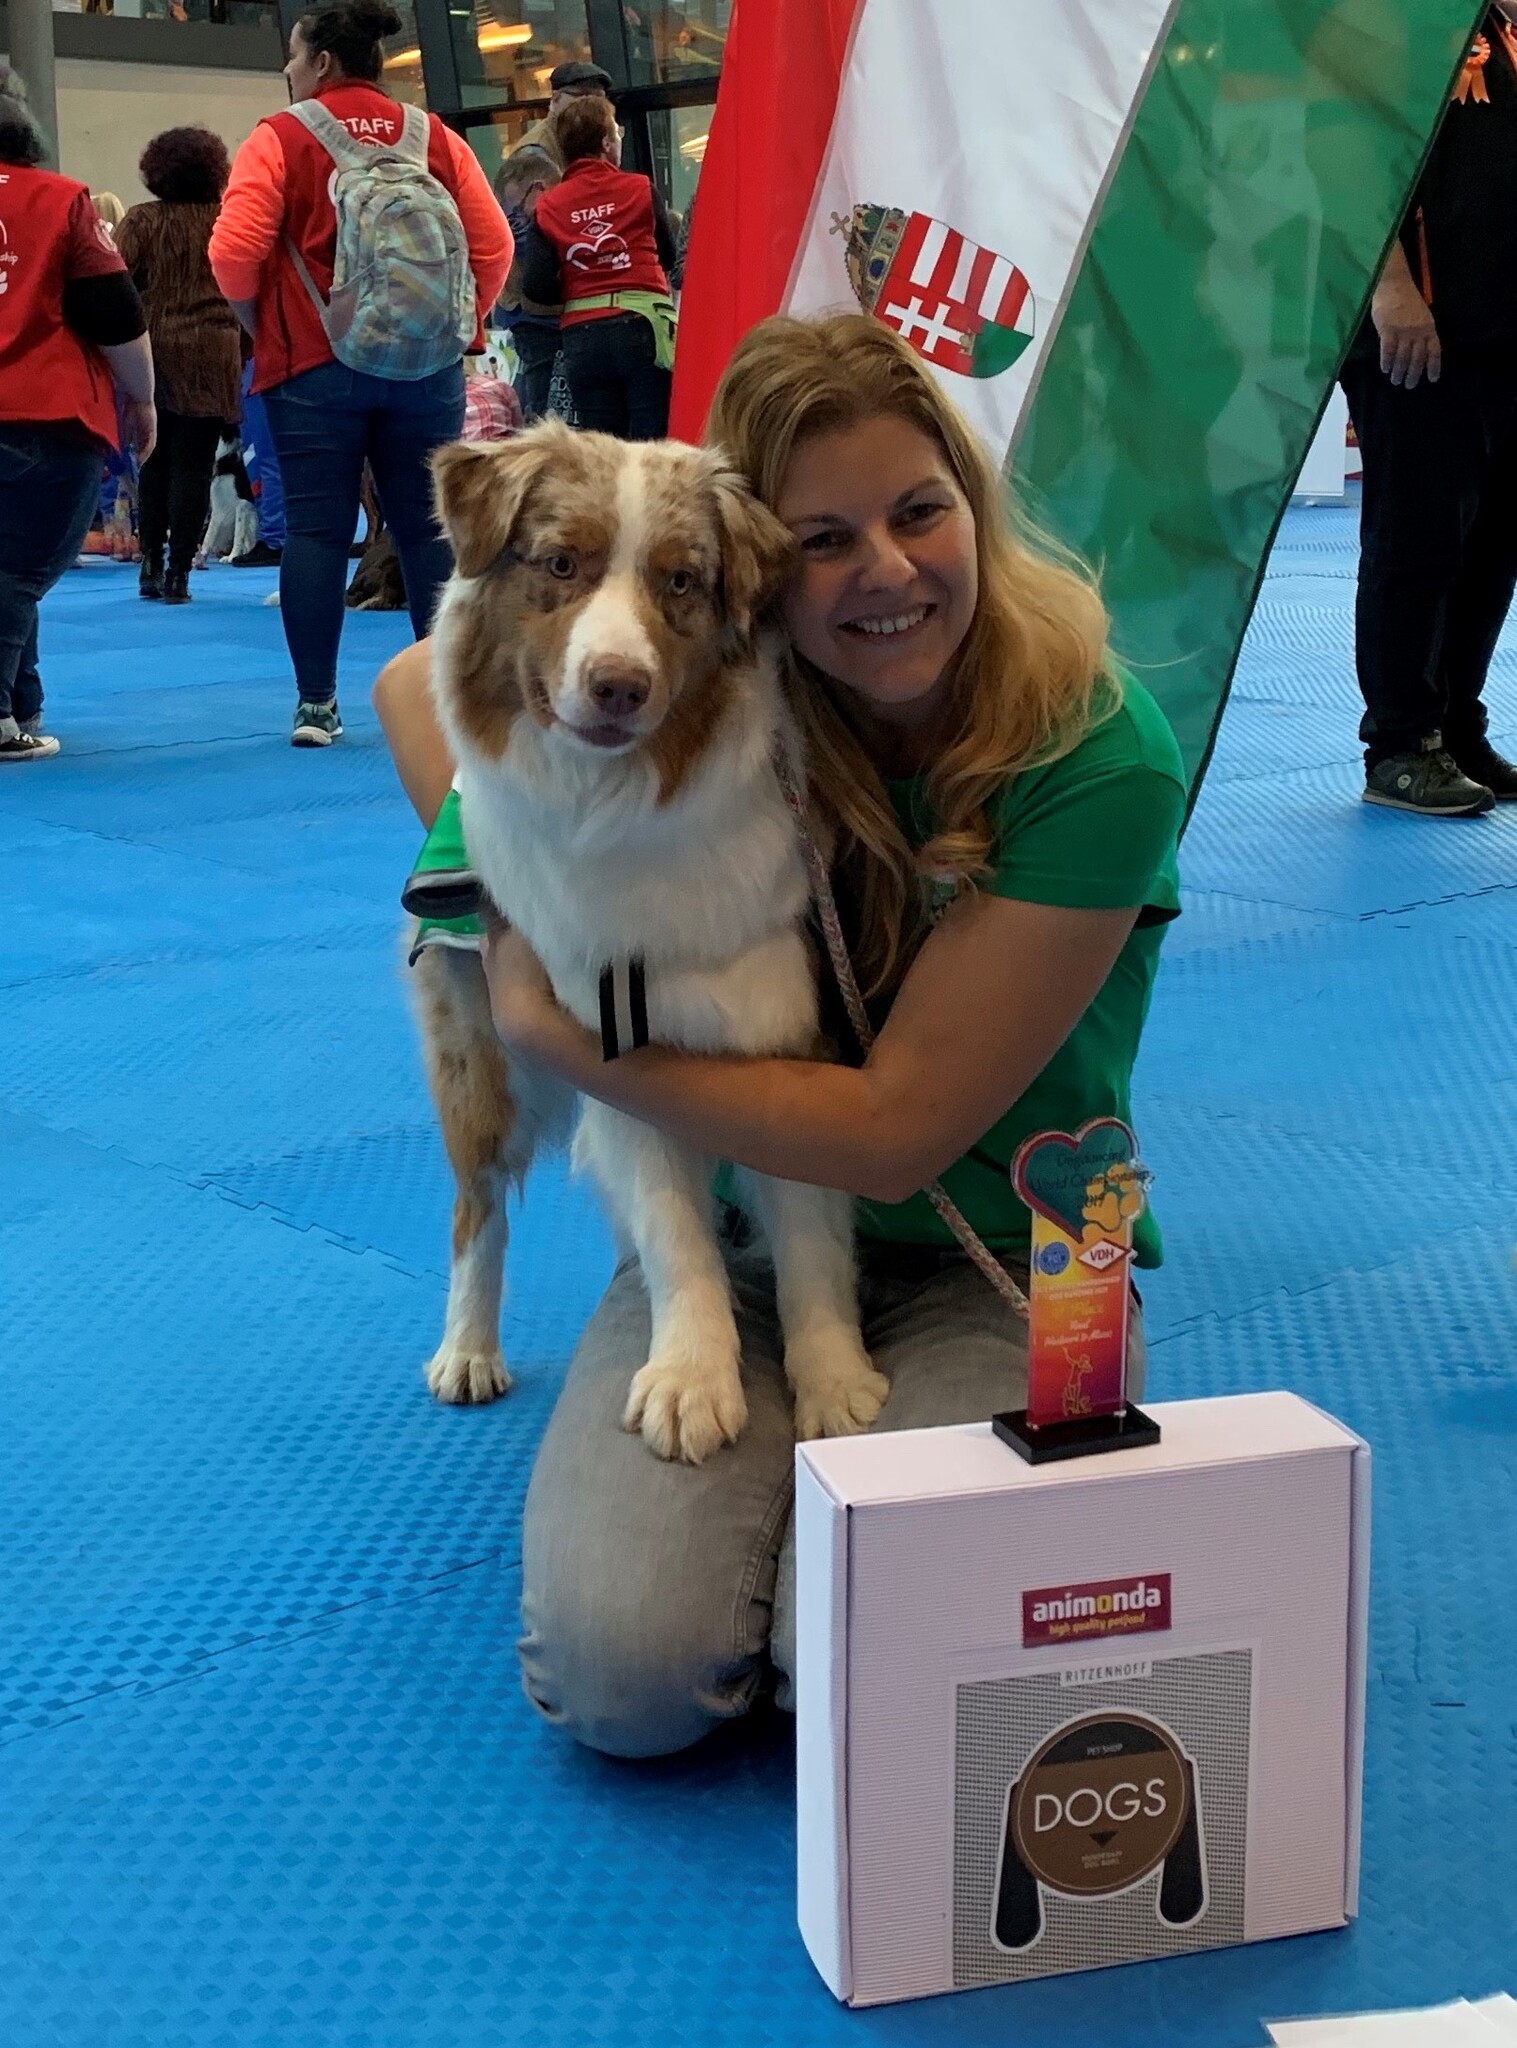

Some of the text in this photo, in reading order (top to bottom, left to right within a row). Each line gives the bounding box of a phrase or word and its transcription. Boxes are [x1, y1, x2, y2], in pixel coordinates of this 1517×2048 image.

[570, 203, 615, 223] STAFF
[1090, 1248, 1114, 1260] VDH
[1033, 1581, 1161, 1622] animonda
[1049, 1622, 1071, 1637] high
[1071, 1617, 1107, 1633] quality
[1065, 1662, 1147, 1682] RITZENHOFF
[1034, 1778, 1167, 1833] DOGS
